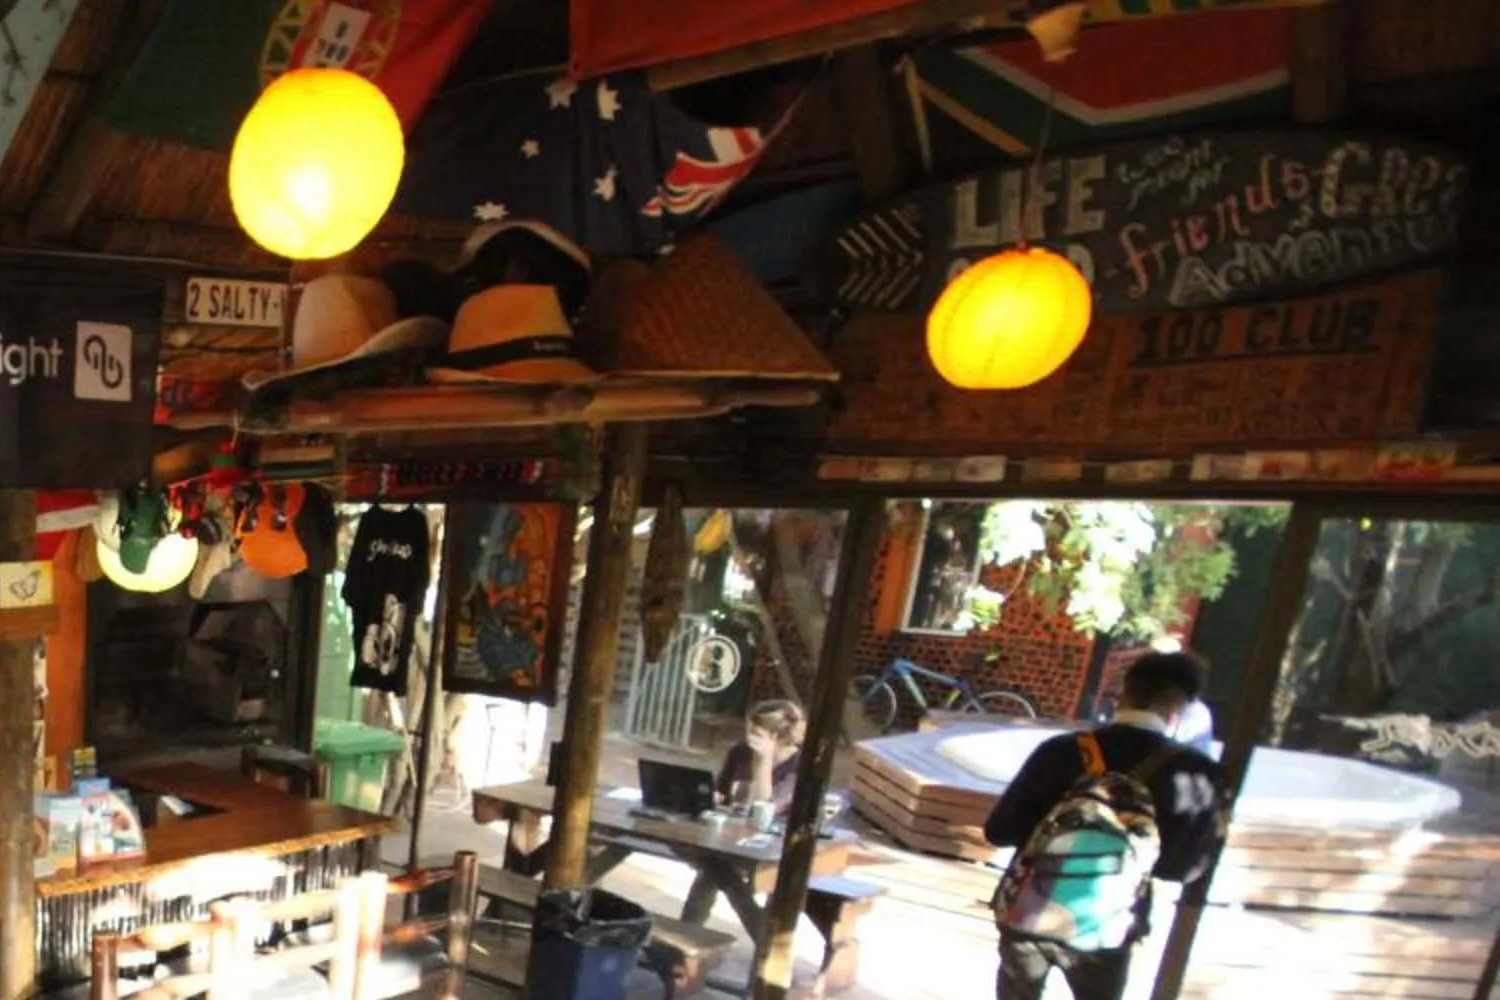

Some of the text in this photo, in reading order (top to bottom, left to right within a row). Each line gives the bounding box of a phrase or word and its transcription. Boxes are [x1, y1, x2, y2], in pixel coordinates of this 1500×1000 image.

[953, 154, 1107, 247] LIFE
[189, 282, 199, 317] 2
[1137, 299, 1380, 362] 100 CLUB
